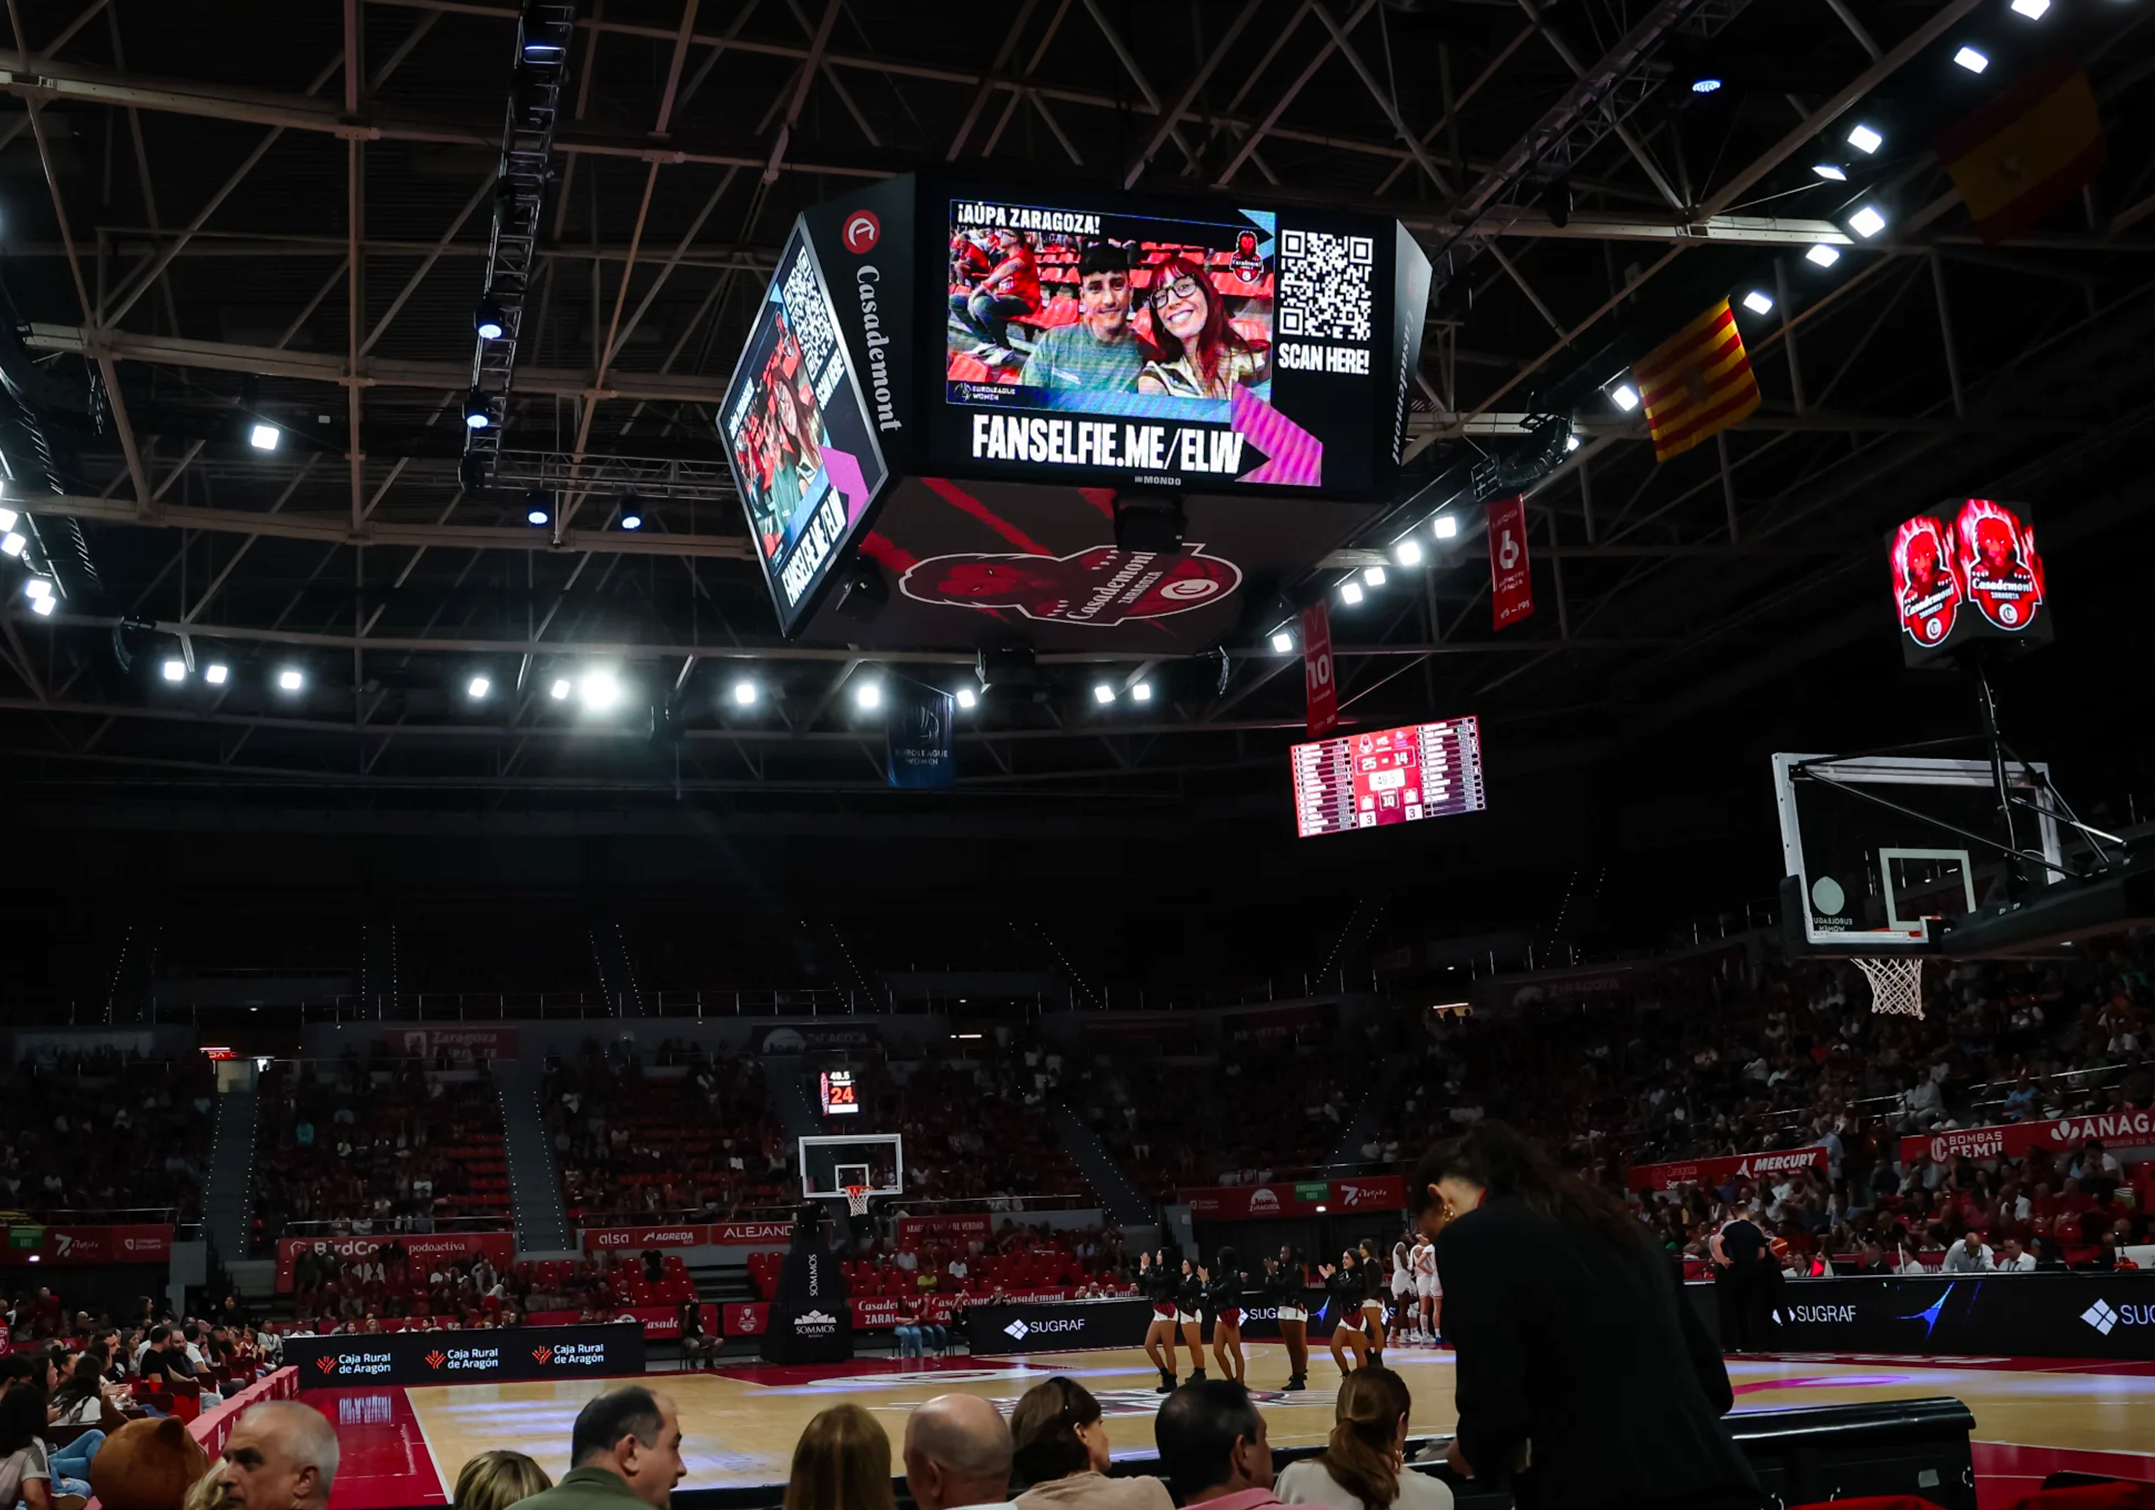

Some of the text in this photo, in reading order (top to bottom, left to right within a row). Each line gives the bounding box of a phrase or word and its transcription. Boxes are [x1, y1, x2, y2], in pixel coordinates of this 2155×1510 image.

[957, 201, 1101, 235] ¡AÚPA ZARAGOZA!
[857, 264, 903, 433] Casademont
[1278, 342, 1370, 375] SCAN HERE!
[972, 385, 1016, 396] EUROLEAGUE
[1391, 308, 1414, 466] Casademont
[972, 392, 1000, 401] WOMEN
[972, 414, 1245, 474] FANSELFIE.ME/ELW
[1143, 475, 1182, 486] MONDO
[1499, 529, 1520, 570] 6
[1118, 571, 1164, 605] ZARAGOZA
[1972, 577, 2034, 592] Casademont
[1904, 584, 1955, 617] Casademont
[1307, 653, 1331, 690] 10
[1361, 756, 1377, 771] 25
[1393, 751, 1409, 766] 14
[1382, 794, 1396, 808] 10
[1366, 814, 1374, 825] 3
[1408, 808, 1416, 820] 3
[830, 1071, 850, 1080] 49.5
[830, 1086, 854, 1104] 24
[1949, 1131, 2003, 1146] BOMBAS
[1753, 1152, 1817, 1172] MERCURY
[598, 1232, 630, 1245] alsa
[655, 1231, 695, 1242] AGREDA
[408, 1241, 466, 1256] podoactiva
[808, 1253, 819, 1297] SOMMOS
[1796, 1304, 1857, 1323] SUGRAF
[795, 1324, 836, 1335] SOMMOS
[1030, 1318, 1086, 1334] SUGRAF
[447, 1347, 499, 1362] Caja Rural
[553, 1343, 604, 1357] Caja Rural
[339, 1352, 391, 1366] Caja Rural
[447, 1356, 499, 1371] de Aragón
[553, 1352, 604, 1367] de Aragón
[339, 1361, 391, 1376] de Aragón
